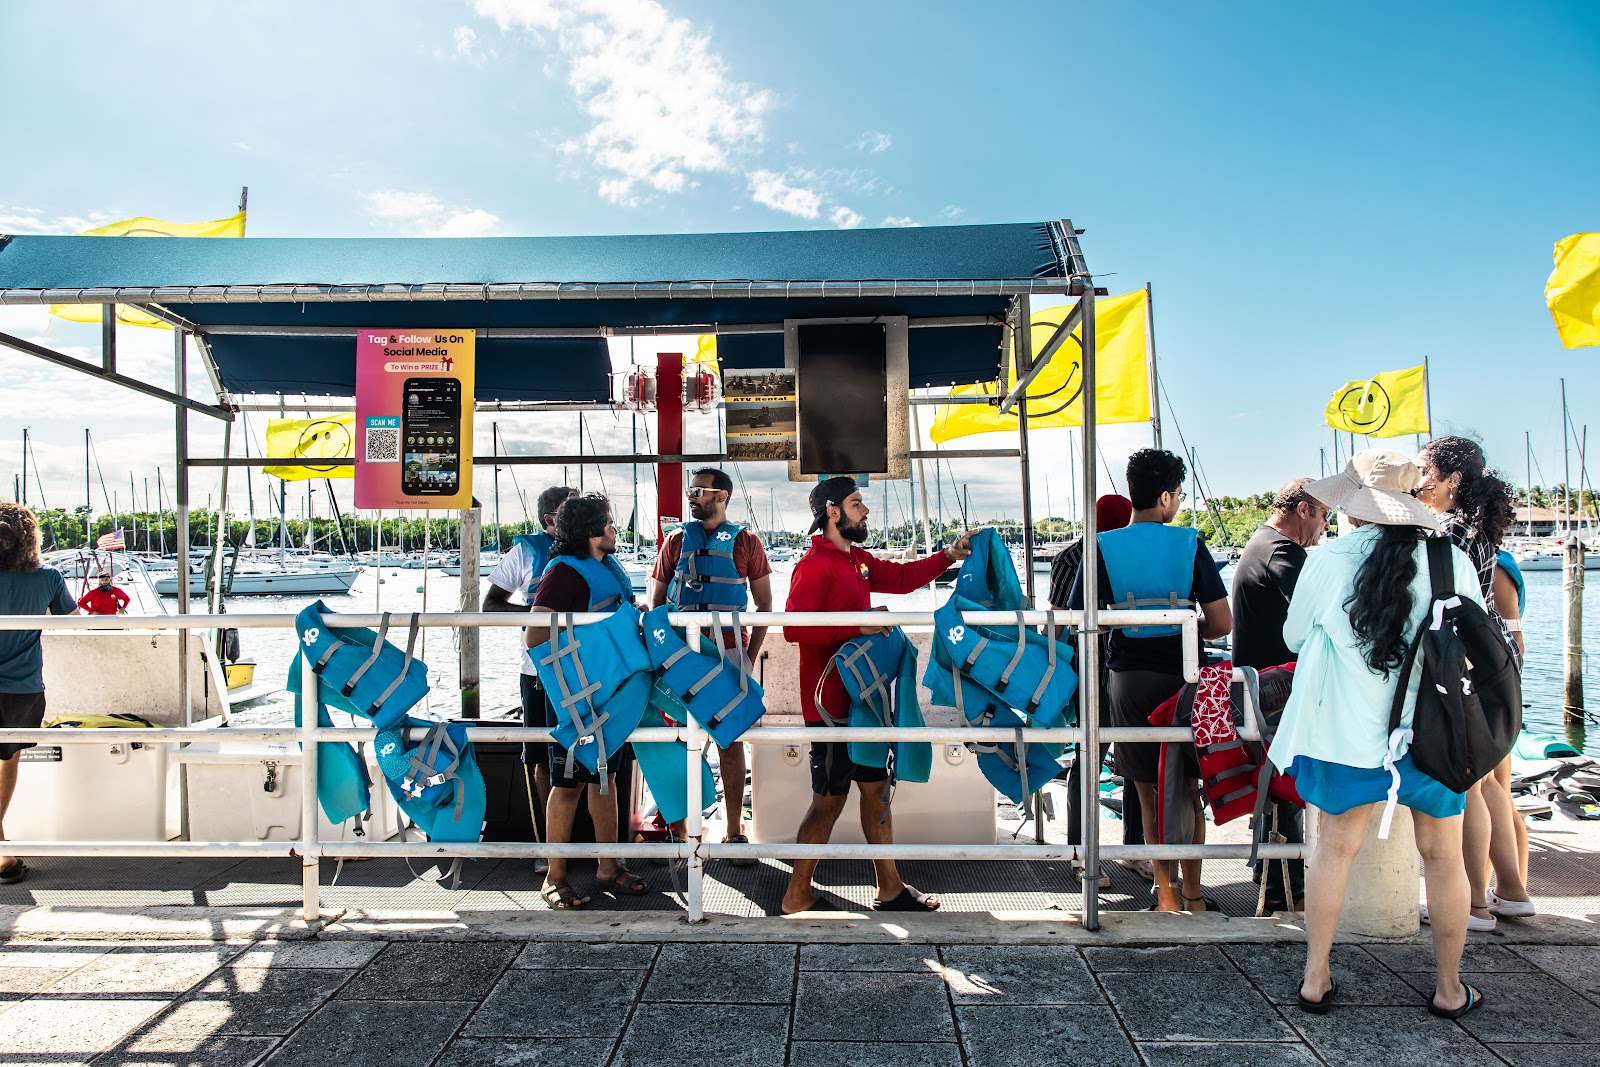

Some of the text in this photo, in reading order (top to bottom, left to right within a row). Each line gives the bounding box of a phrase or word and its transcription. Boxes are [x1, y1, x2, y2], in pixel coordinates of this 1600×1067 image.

[368, 335, 464, 346] Tag & Follow Us On
[384, 347, 447, 356] Social Media
